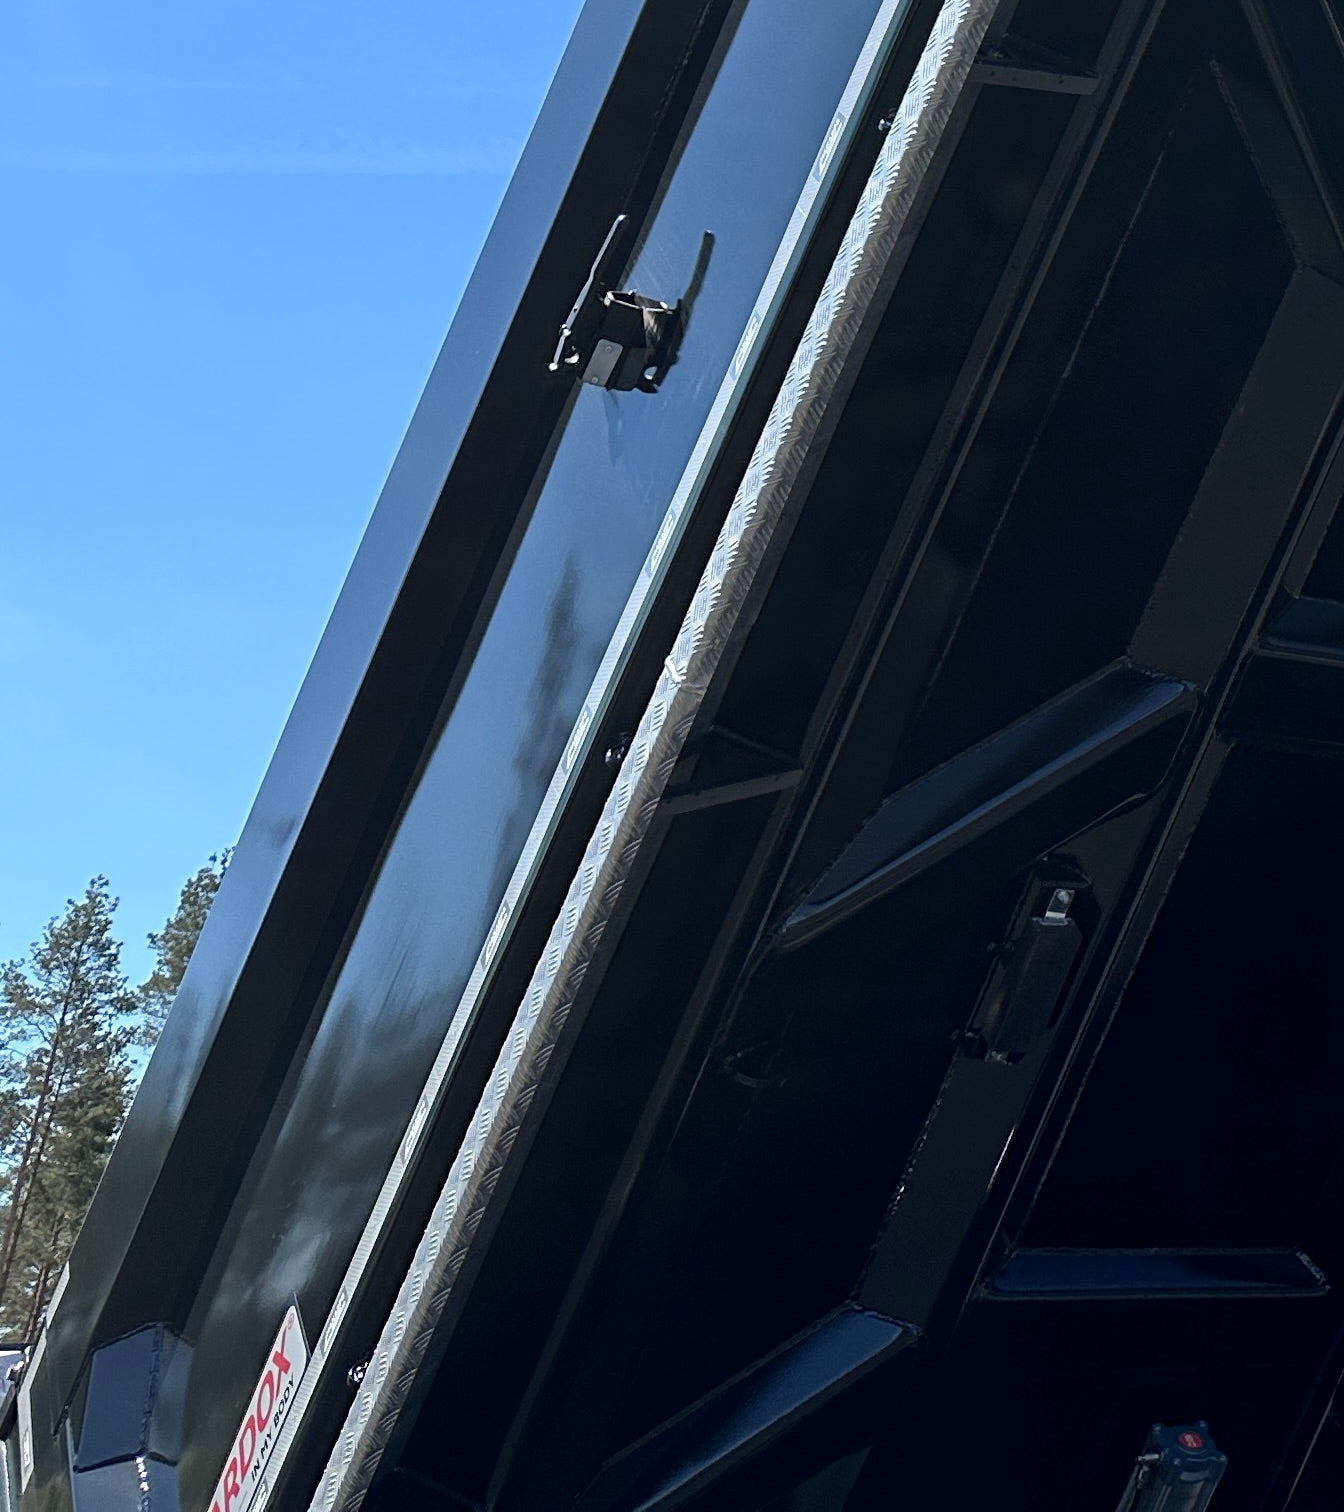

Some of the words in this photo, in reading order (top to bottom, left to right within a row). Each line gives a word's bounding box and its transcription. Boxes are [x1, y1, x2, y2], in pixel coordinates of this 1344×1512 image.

[251, 1457, 260, 1483] IN
[260, 1432, 273, 1460] MY
[273, 1372, 295, 1428] BODY
